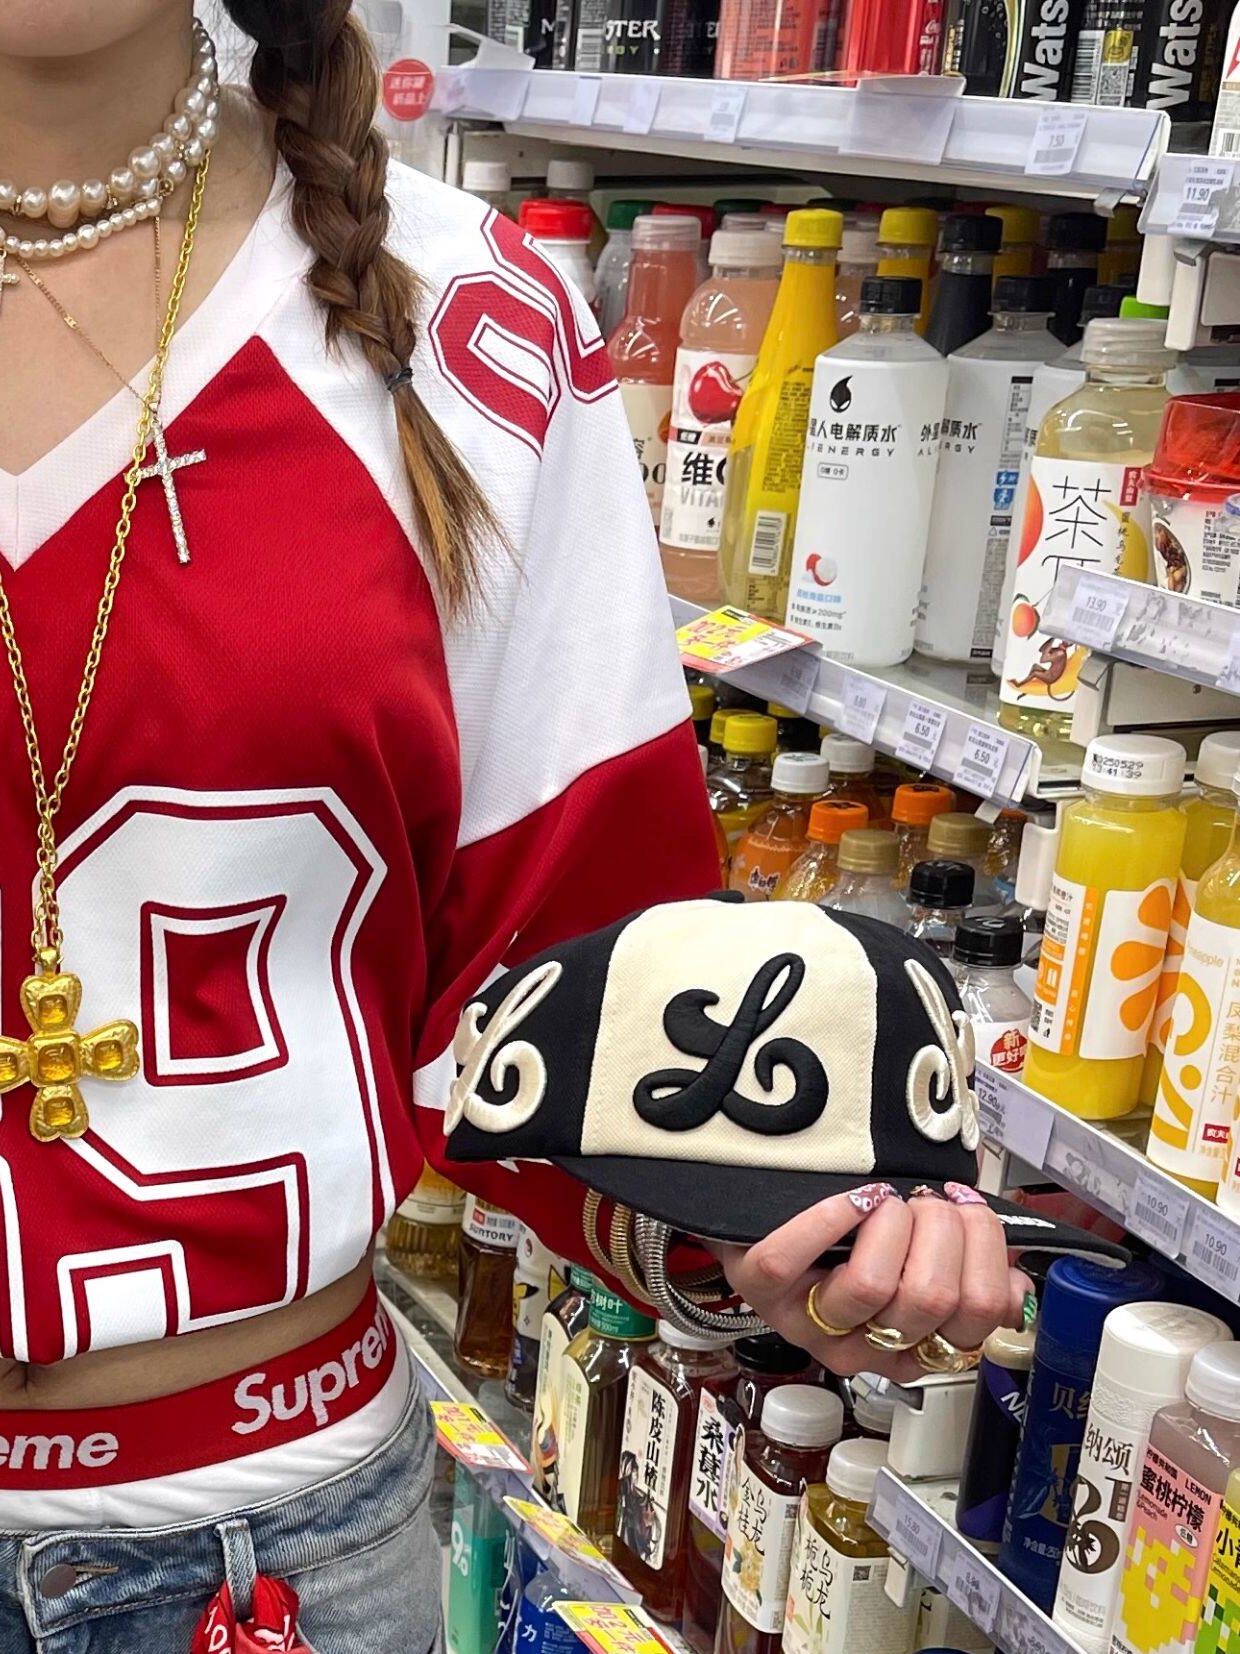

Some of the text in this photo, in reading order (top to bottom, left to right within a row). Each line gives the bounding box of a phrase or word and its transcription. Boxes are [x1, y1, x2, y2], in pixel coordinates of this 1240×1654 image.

[1140, 1464, 1205, 1533] 蜜桃柠檬
[1184, 1478, 1212, 1506] LEMON
